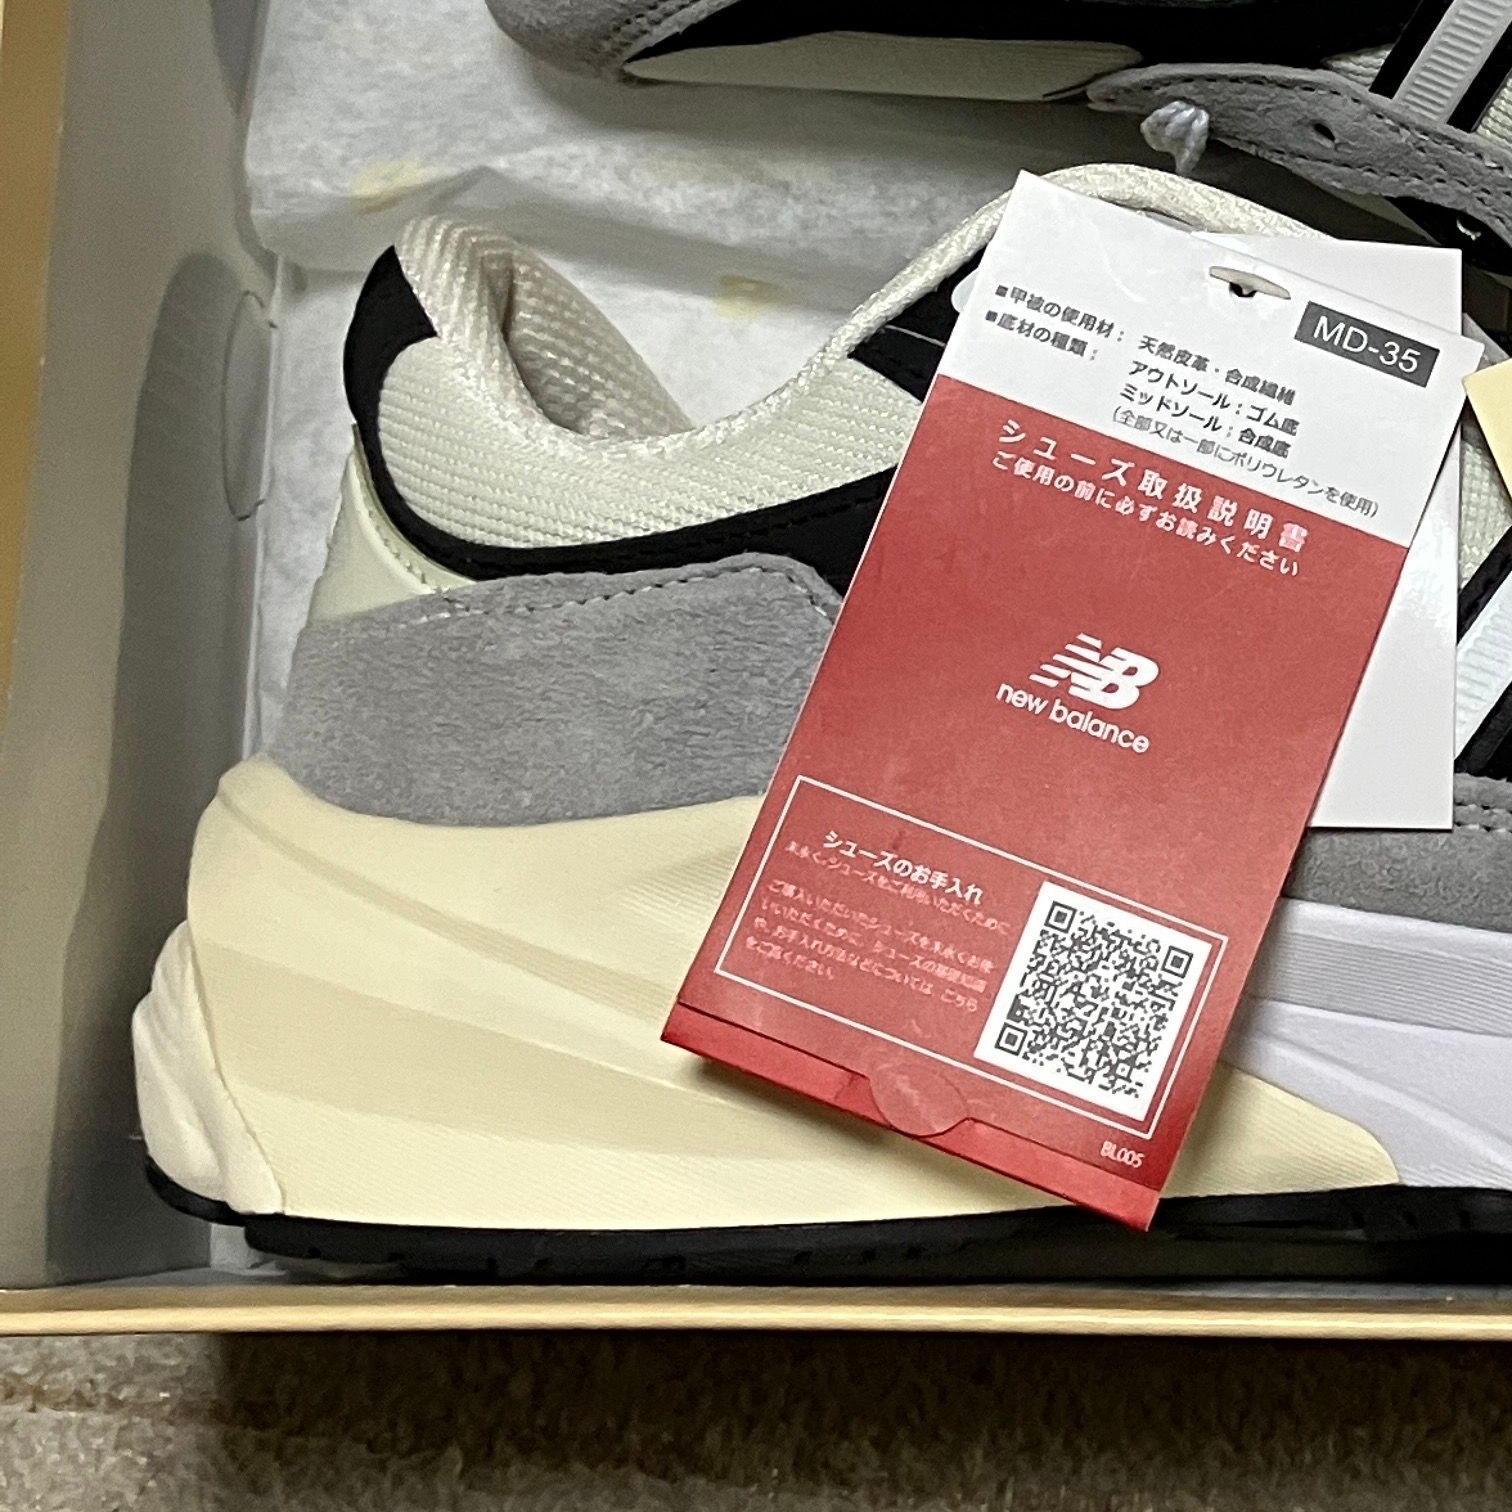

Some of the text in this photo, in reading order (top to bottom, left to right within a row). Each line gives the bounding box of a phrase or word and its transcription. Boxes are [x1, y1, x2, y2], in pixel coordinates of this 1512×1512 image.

[1313, 315, 1421, 373] MD-35
[992, 450, 1300, 576] ご使用の前に必ずお読みください
[996, 683, 1150, 753] new balance
[823, 830, 984, 905] シューズのお手入れ
